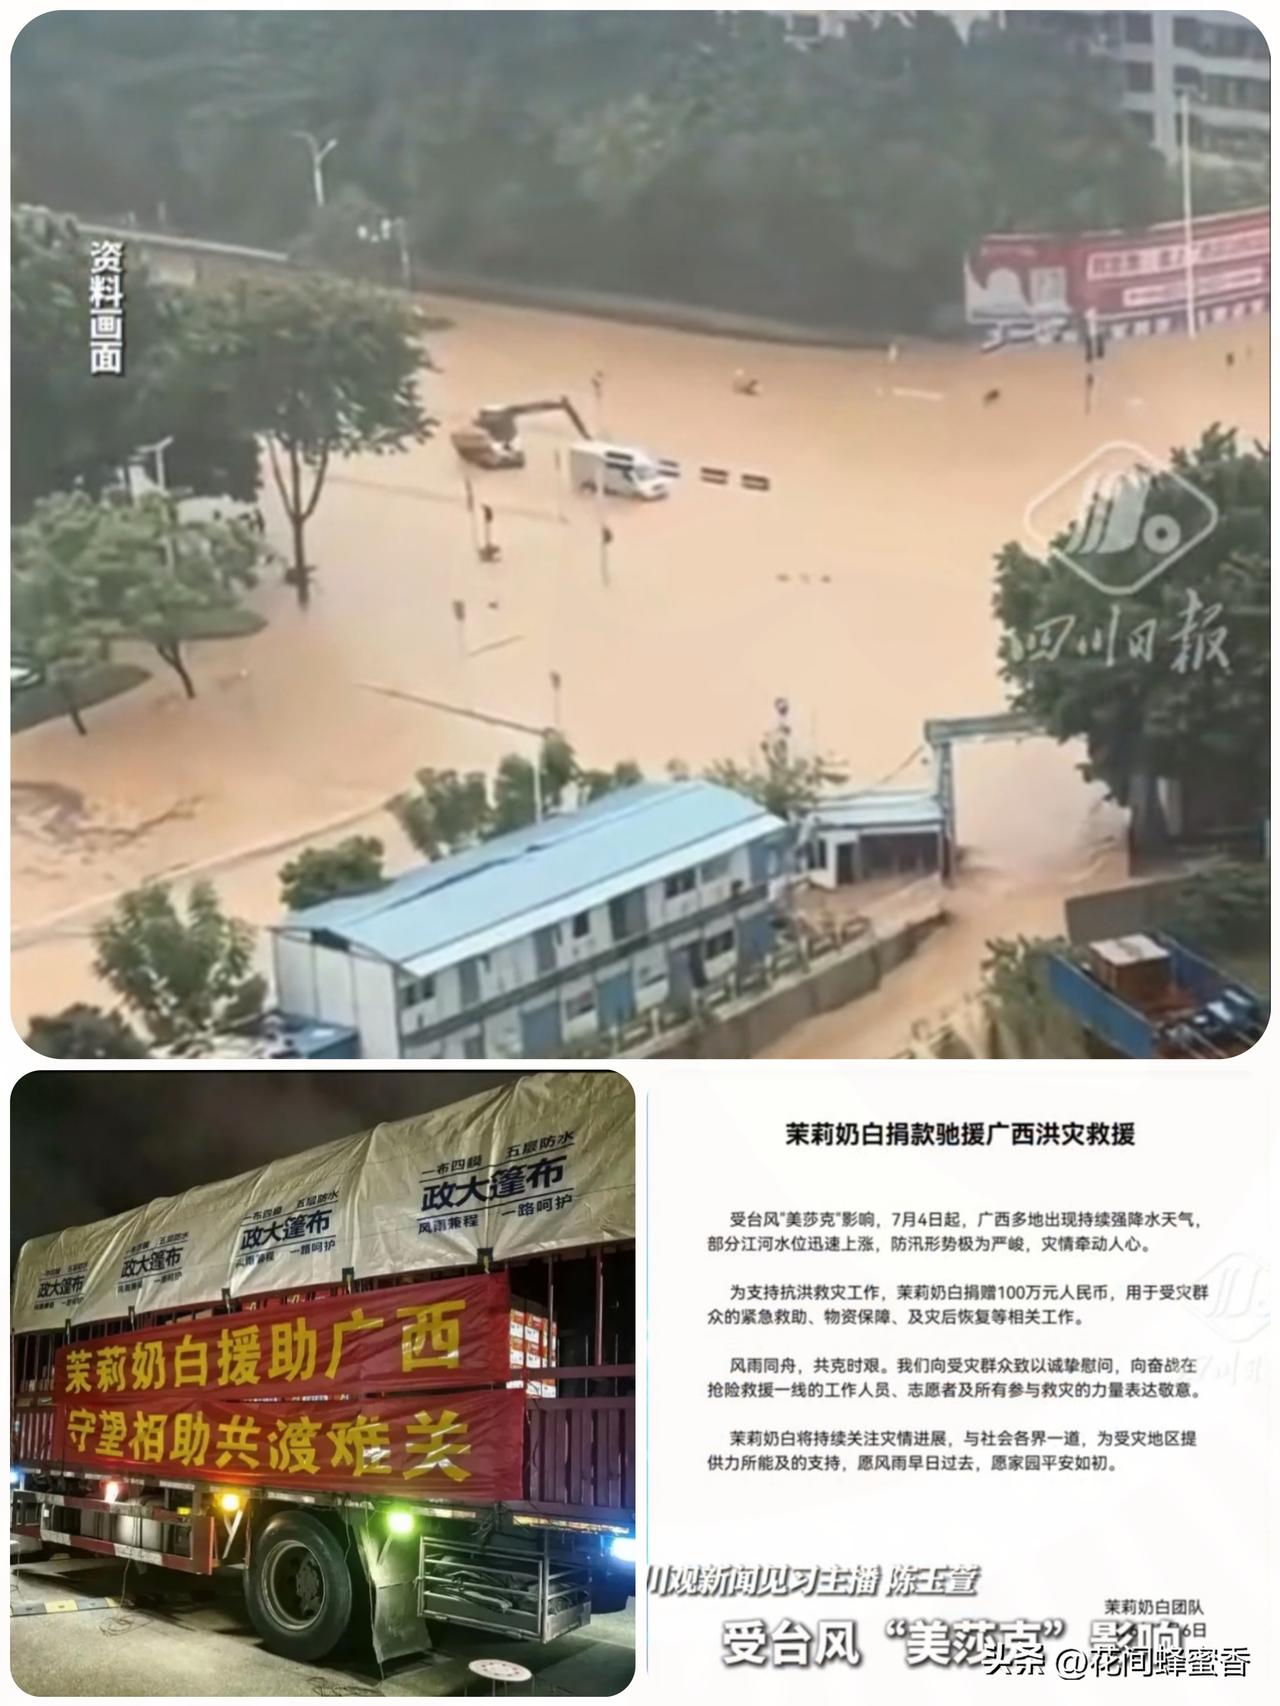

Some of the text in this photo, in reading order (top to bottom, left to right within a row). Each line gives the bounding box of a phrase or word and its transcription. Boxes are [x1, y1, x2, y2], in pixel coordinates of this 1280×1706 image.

[786, 1121, 1136, 1147] 茉莉奶白捐款驰援广西洪灾救援
[421, 1155, 567, 1211] 政大篷布
[240, 1209, 332, 1250] 政大篷布
[65, 1299, 467, 1395] 茉莉奶白援助广西
[66, 1409, 472, 1483] 守望相助共渡难关
[1104, 1598, 1205, 1615] 茉莉奶白团队
